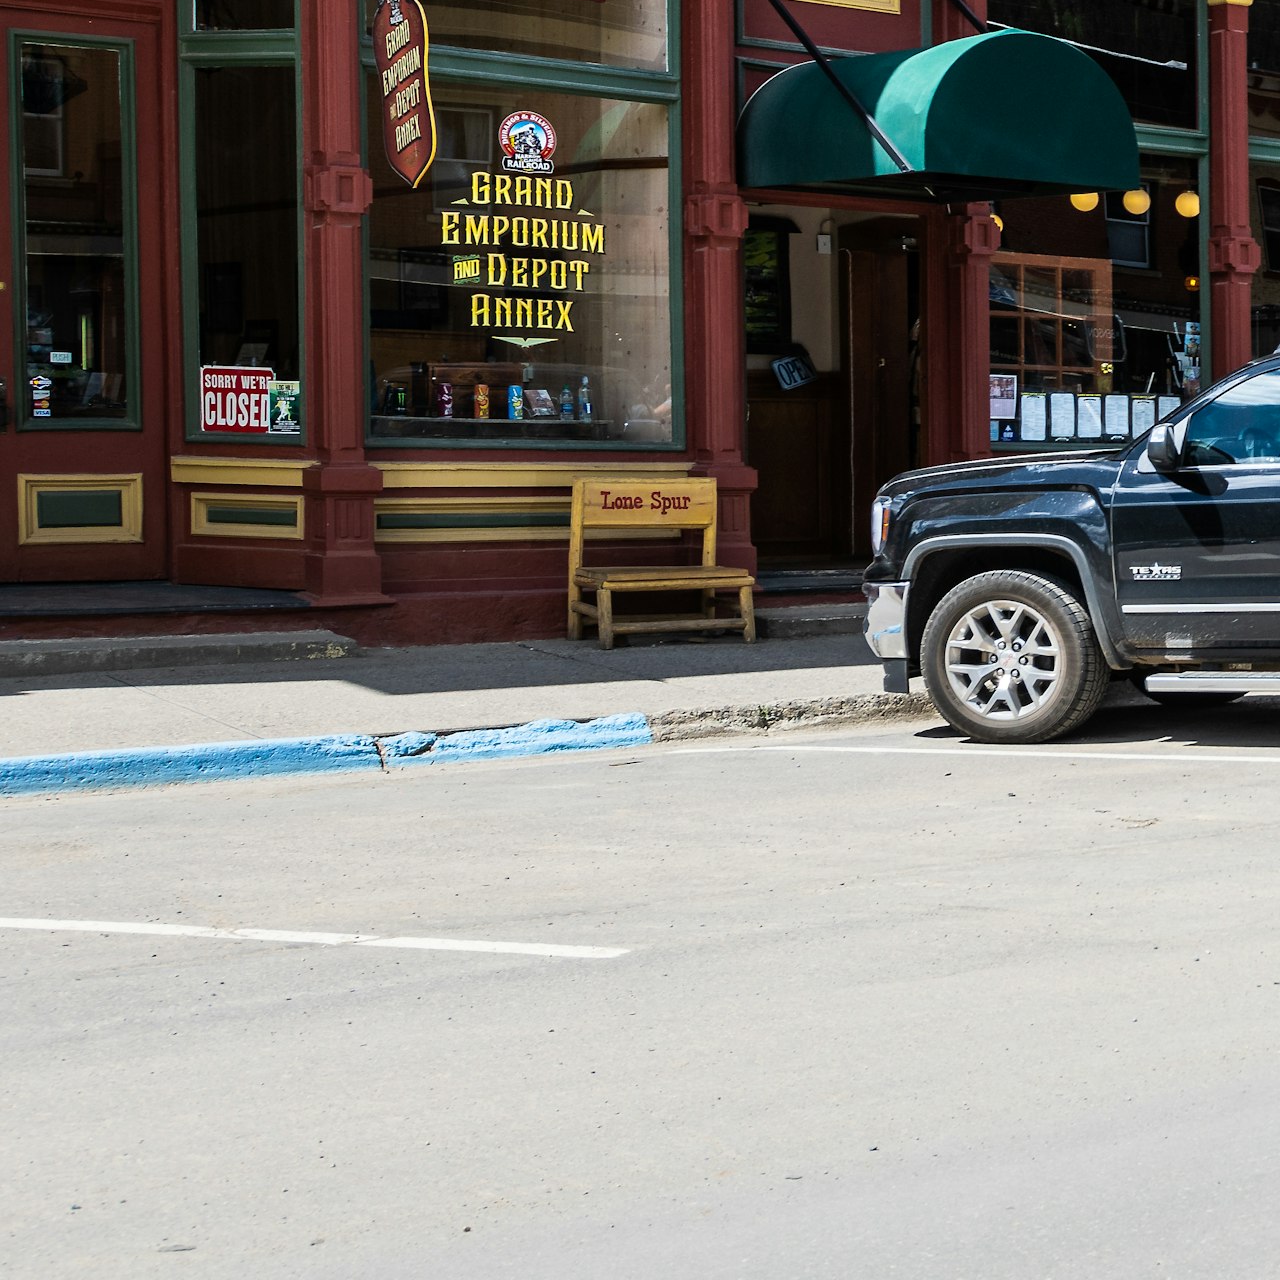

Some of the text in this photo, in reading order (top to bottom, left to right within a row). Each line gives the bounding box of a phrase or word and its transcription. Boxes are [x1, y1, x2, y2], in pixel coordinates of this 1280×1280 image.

[386, 19, 410, 60] GRAND
[383, 46, 421, 97] EMPORIUM
[396, 79, 420, 118] DEPOT
[395, 113, 421, 153] ANNEX
[507, 160, 550, 170] RAILROAD
[471, 171, 573, 210] GRAND
[441, 211, 605, 254] EMPORIUM
[454, 253, 589, 291] AND DEPOT
[470, 293, 574, 332] ANNEX
[205, 374, 237, 388] SORRY
[205, 391, 269, 427] CLOSED
[600, 491, 691, 515] Lone Spur
